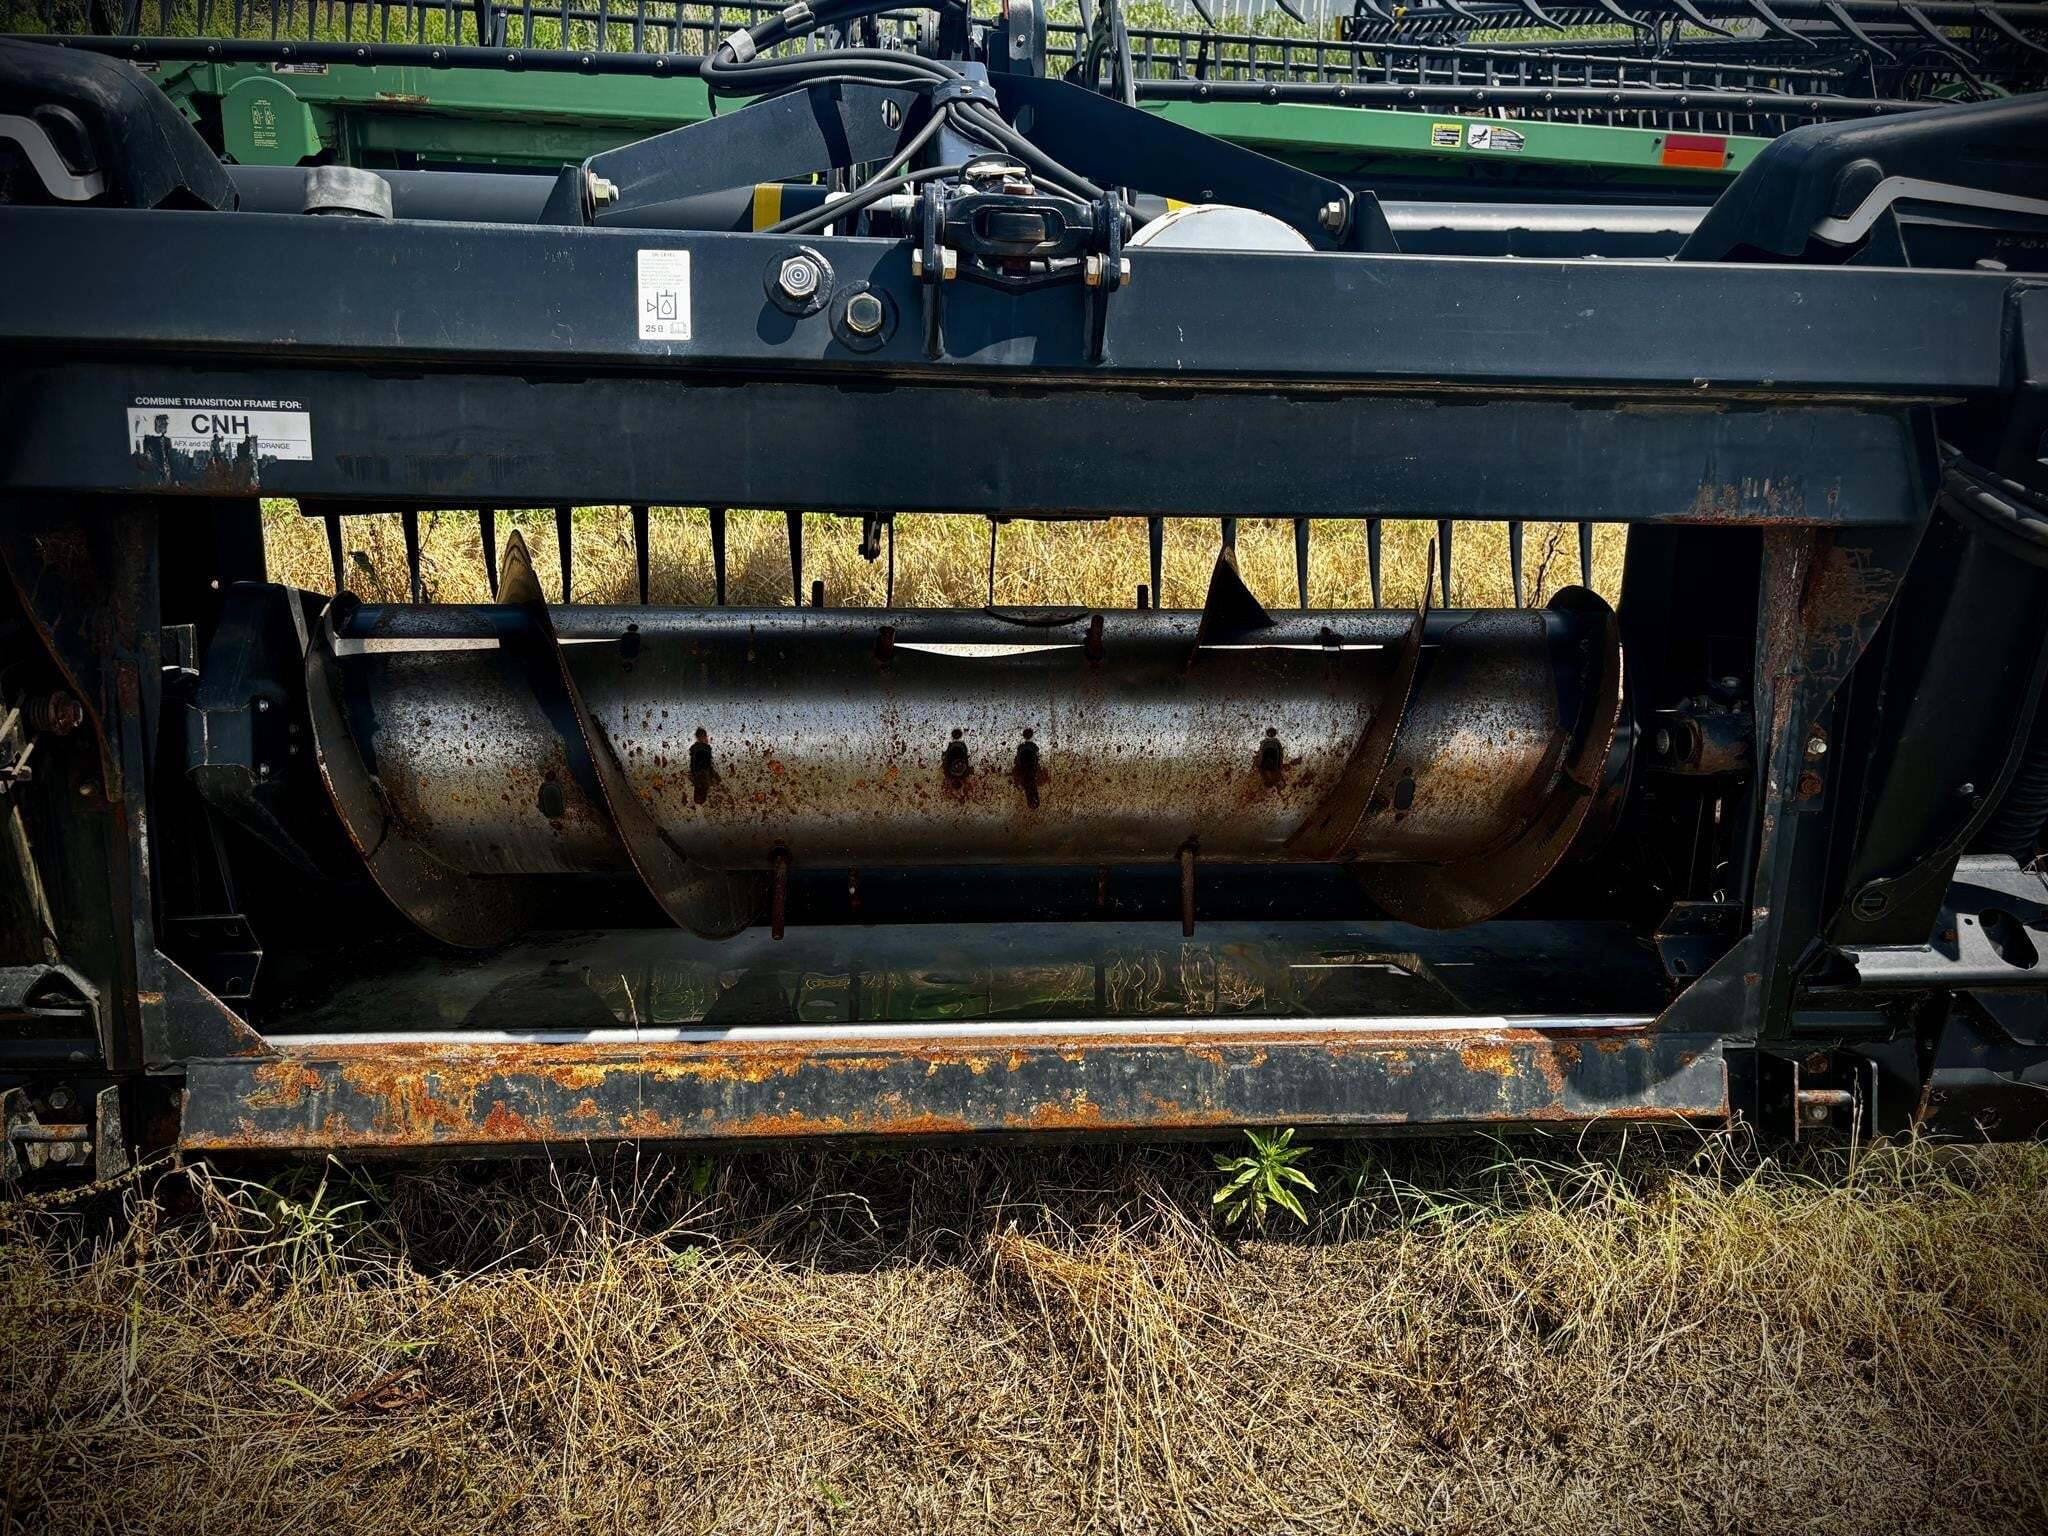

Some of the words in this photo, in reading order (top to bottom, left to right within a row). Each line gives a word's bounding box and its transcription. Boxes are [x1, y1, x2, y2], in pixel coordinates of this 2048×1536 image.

[135, 396, 182, 406] COMBINE
[183, 397, 241, 408] TRANSITION
[243, 399, 278, 409] FRAME
[279, 400, 302, 410] FOR:
[191, 413, 250, 435] CNH
